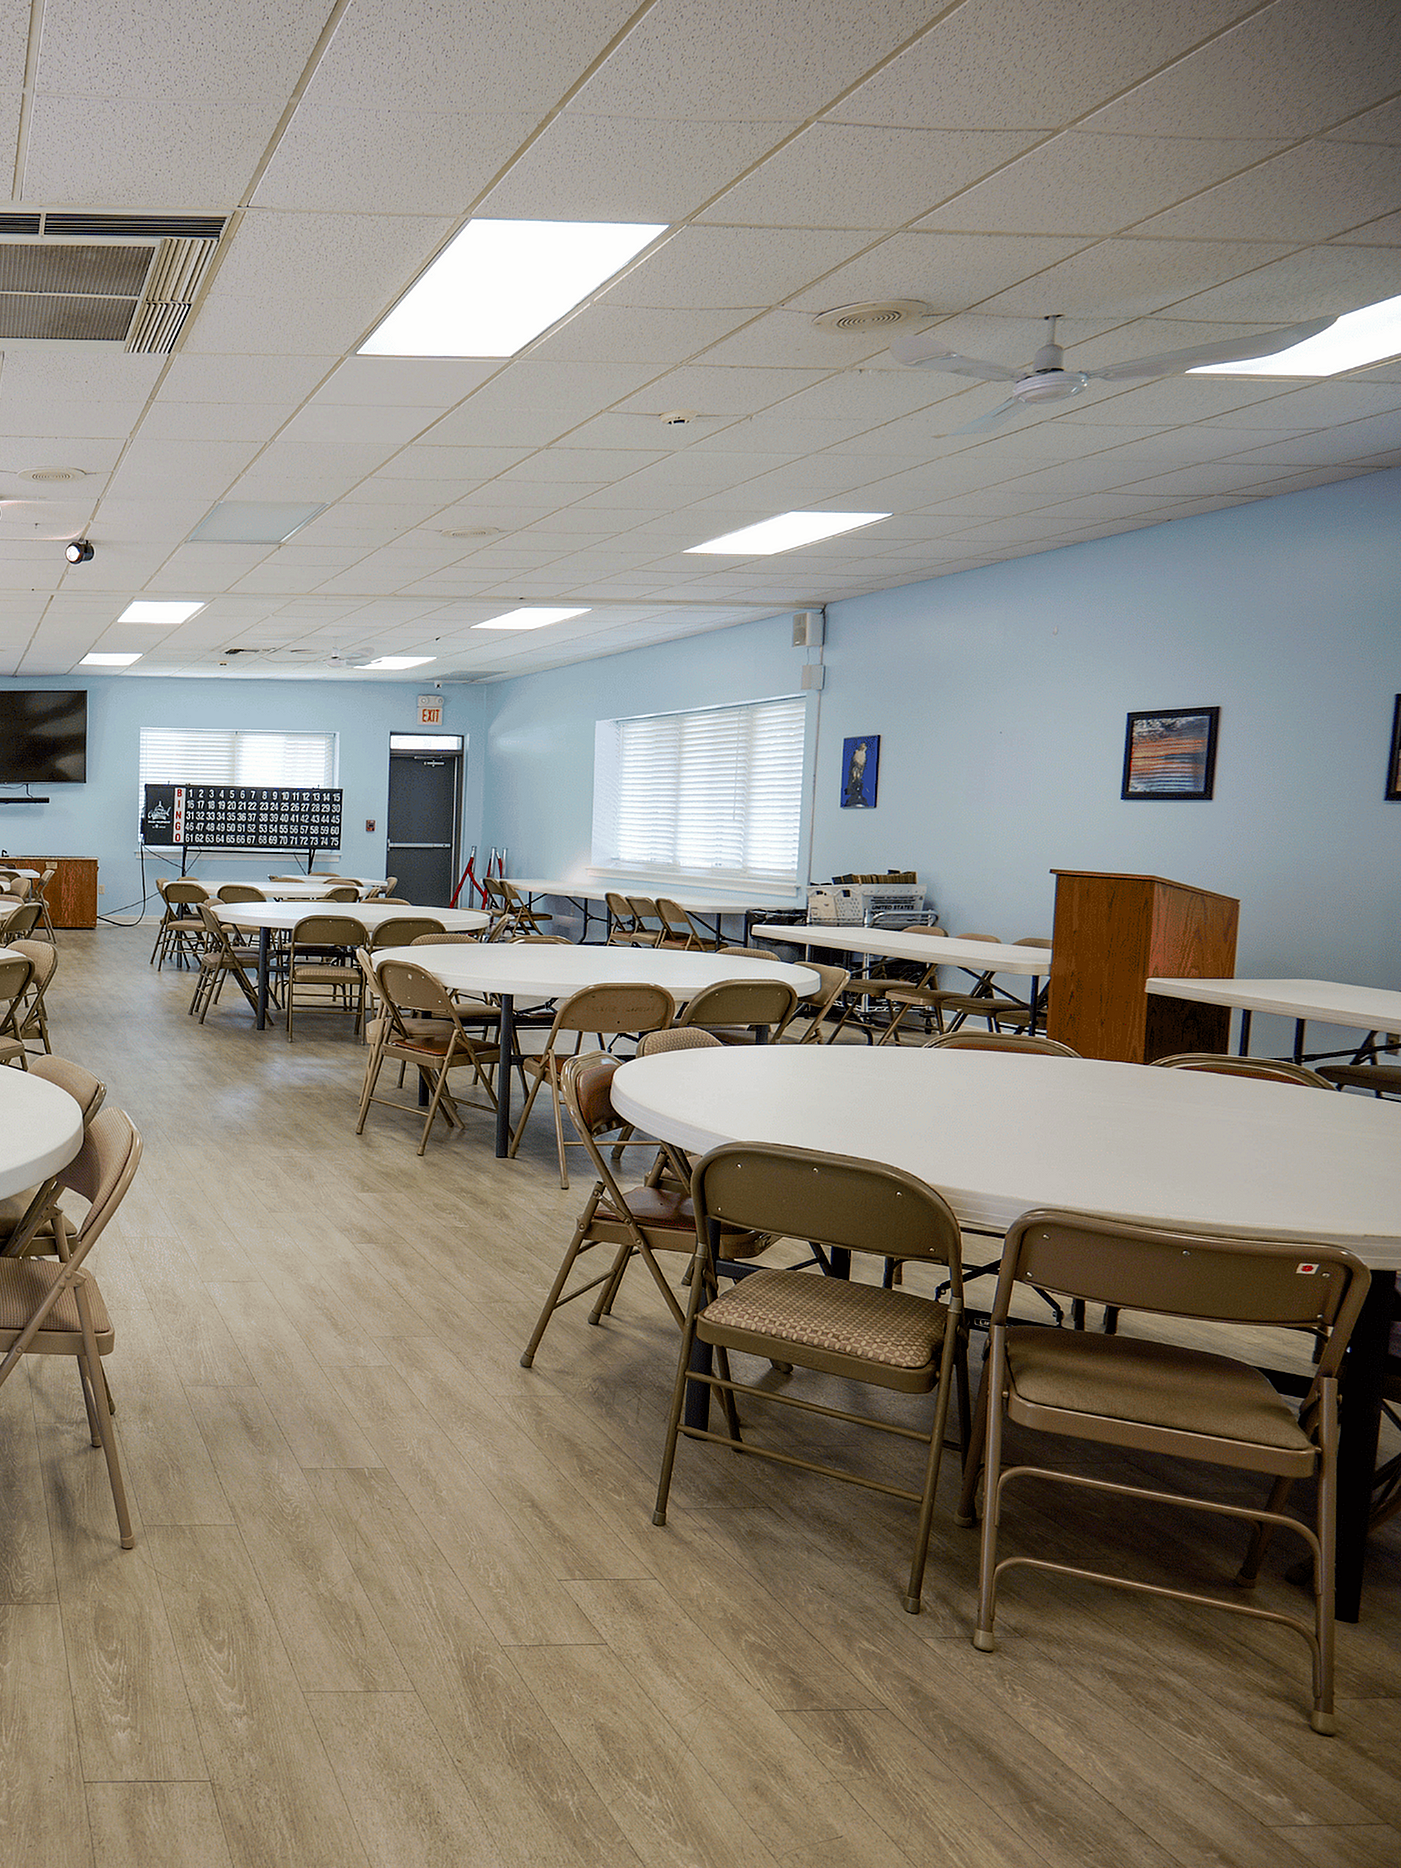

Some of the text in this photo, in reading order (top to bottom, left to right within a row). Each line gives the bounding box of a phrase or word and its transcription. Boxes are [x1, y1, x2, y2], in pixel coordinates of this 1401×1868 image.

[422, 709, 440, 722] EXIT
[282, 792, 289, 800] 10
[292, 792, 299, 801] 11
[302, 792, 310, 801] 12
[312, 793, 320, 801] 13
[323, 793, 330, 801] 14
[333, 793, 340, 802] 15
[187, 800, 340, 813] 16 17 18 19 20 21 22 23 24 25 26 27 28 29 30
[186, 811, 340, 824] 31 32 33 34 35 36 37 38 39 40 41 42 43 44 45
[185, 822, 339, 835] 46 47 48 49 50 51 52 53 54 55 56 57 58 59 60
[185, 833, 339, 846] 61 62 63 64 65 66 67 68 69 70 71 72 73 74 75
